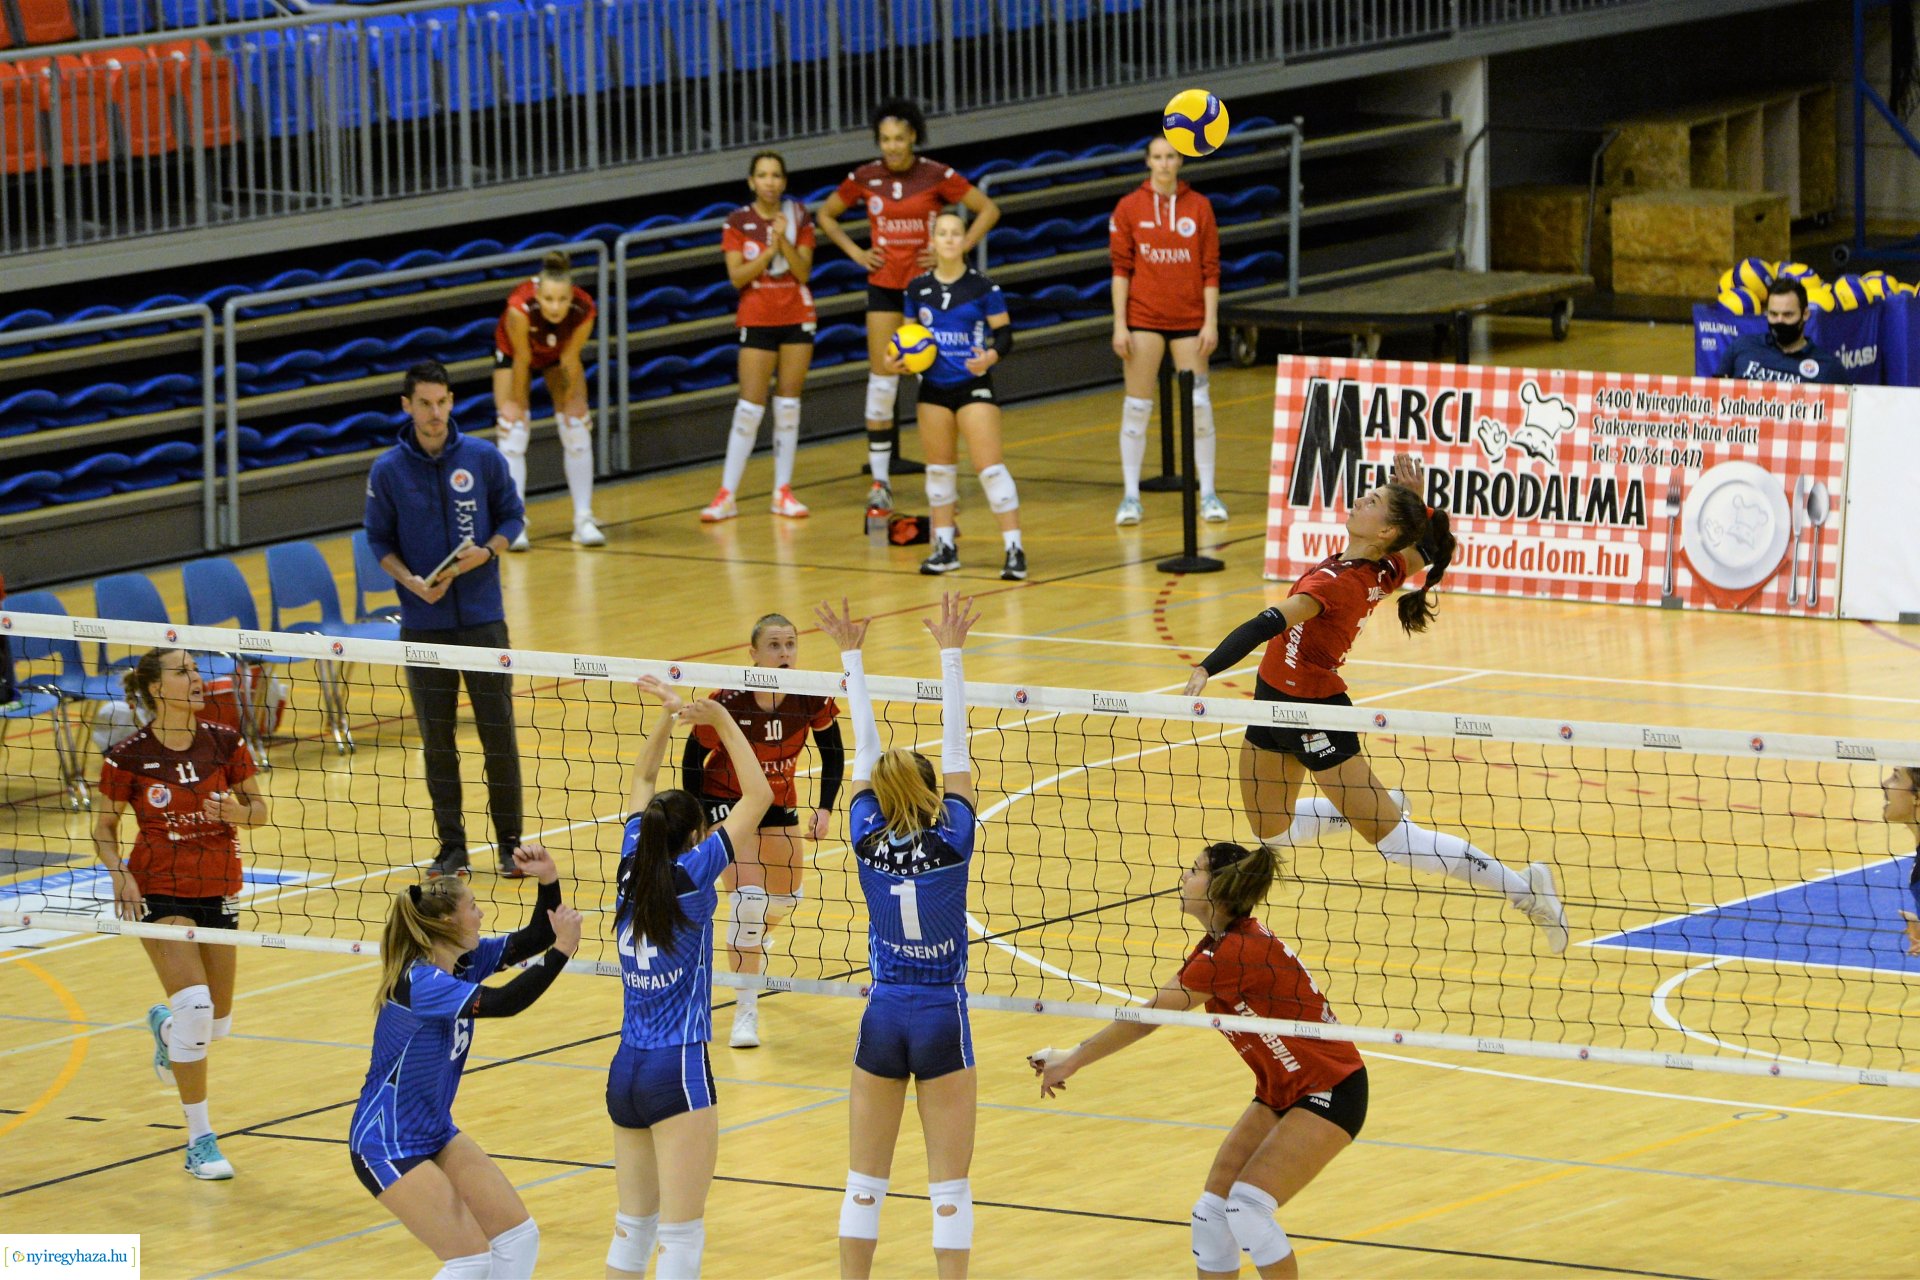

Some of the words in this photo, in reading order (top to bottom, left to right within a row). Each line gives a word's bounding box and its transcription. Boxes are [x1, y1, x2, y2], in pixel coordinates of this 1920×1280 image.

[1140, 243, 1191, 263] FATUM
[1743, 361, 1801, 385] FATUM
[1596, 389, 1631, 409] 4400
[1636, 390, 1715, 416] Nyíregyháza,
[1720, 396, 1784, 420] Szabadság
[1790, 400, 1807, 419] tér
[1593, 417, 1688, 439] Szakszervezetek
[1692, 422, 1722, 441] háza
[1726, 426, 1759, 444] alatt
[1289, 377, 1473, 508] MARCI
[73, 620, 107, 636] FATUM
[238, 633, 271, 648] FATUM
[405, 646, 439, 660] FATUM
[574, 658, 607, 673] FATUM
[744, 669, 778, 684] FATUM
[917, 681, 942, 696] FATU
[1092, 694, 1128, 709] FATUM
[1272, 705, 1308, 720] FATUM
[764, 719, 783, 741] 10
[1454, 717, 1492, 732] FATUM
[1642, 729, 1682, 744] FATUM
[1318, 746, 1336, 758] JAKO
[1835, 740, 1875, 756] FATUM
[175, 761, 200, 784] 11
[710, 804, 730, 823] 10
[874, 840, 927, 865] MTK
[863, 857, 941, 876] BUDAPEST
[890, 879, 922, 941] 1
[766, 977, 791, 990] FATUM
[1294, 1023, 1321, 1035] FATUM
[1309, 1096, 1331, 1109] JAKO
